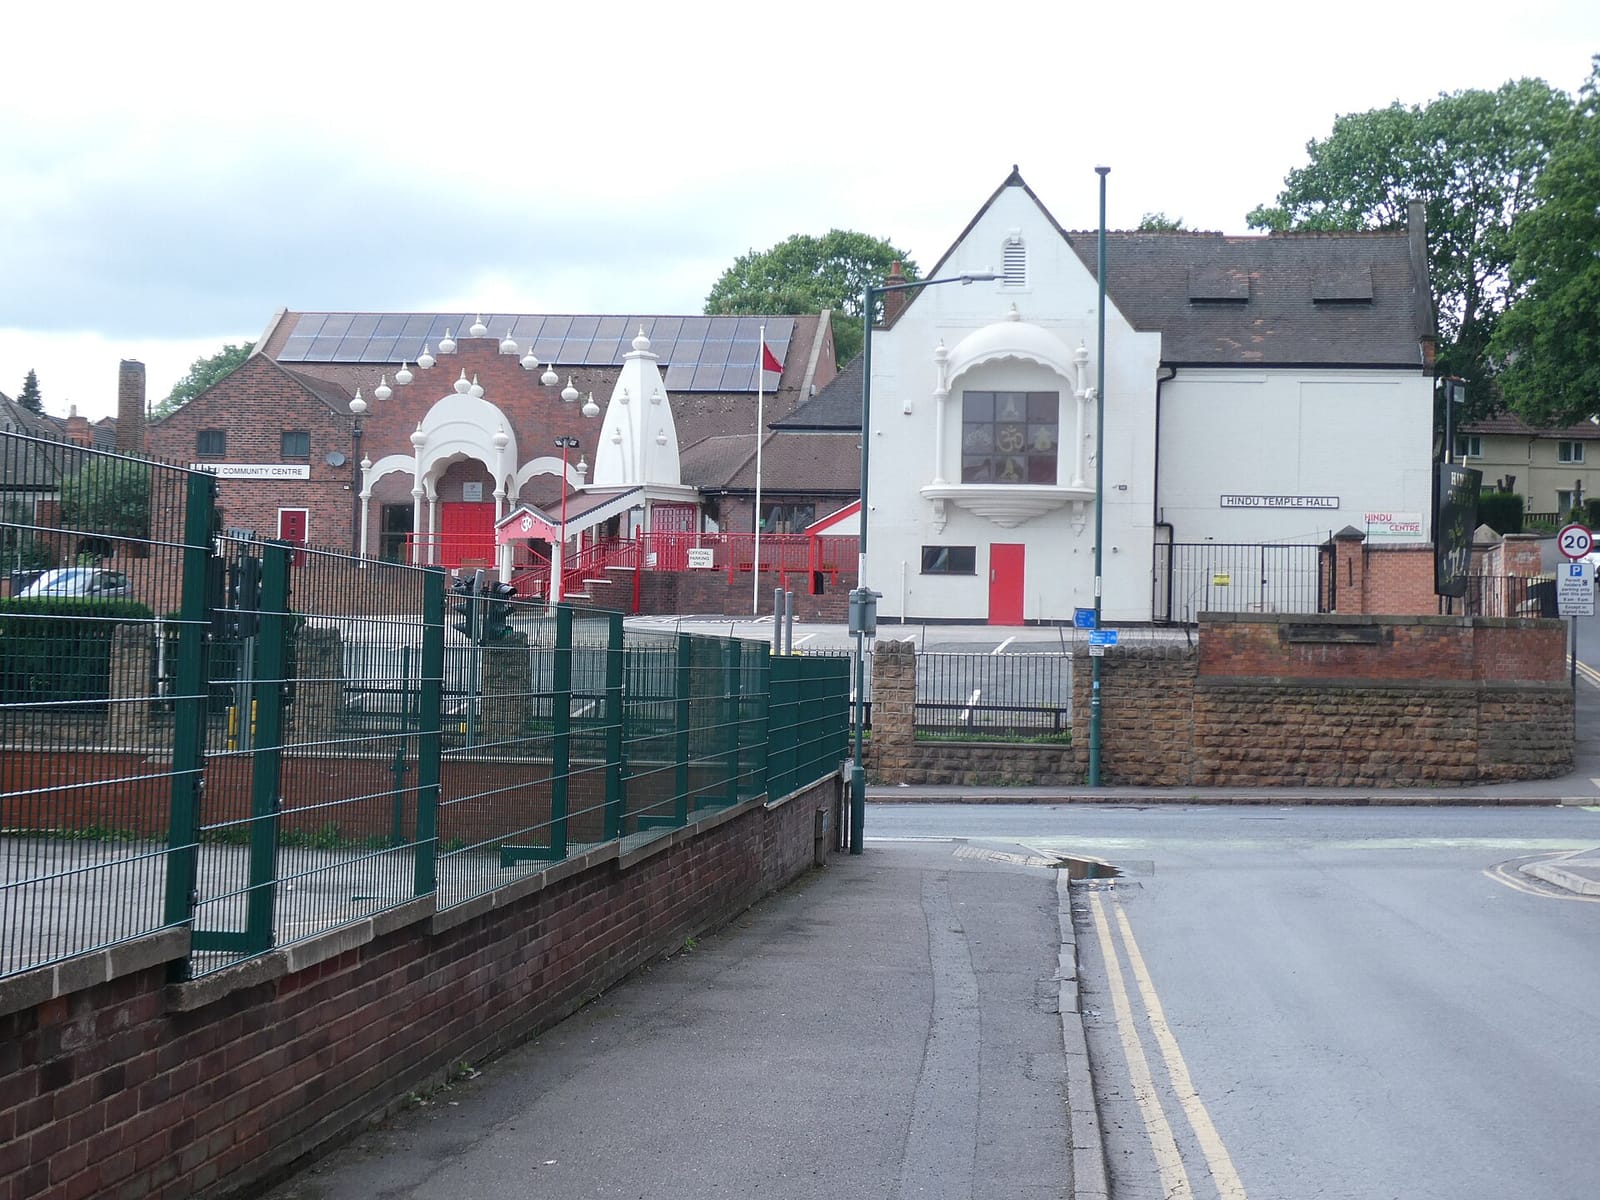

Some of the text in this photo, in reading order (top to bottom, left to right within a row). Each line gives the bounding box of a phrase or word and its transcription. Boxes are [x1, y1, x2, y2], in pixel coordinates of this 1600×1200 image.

[222, 467, 269, 475] COMMUNITY
[1226, 497, 1332, 506] HINDU TEMPLE HALL
[1364, 513, 1392, 521] HINDU
[1564, 535, 1588, 549] 20
